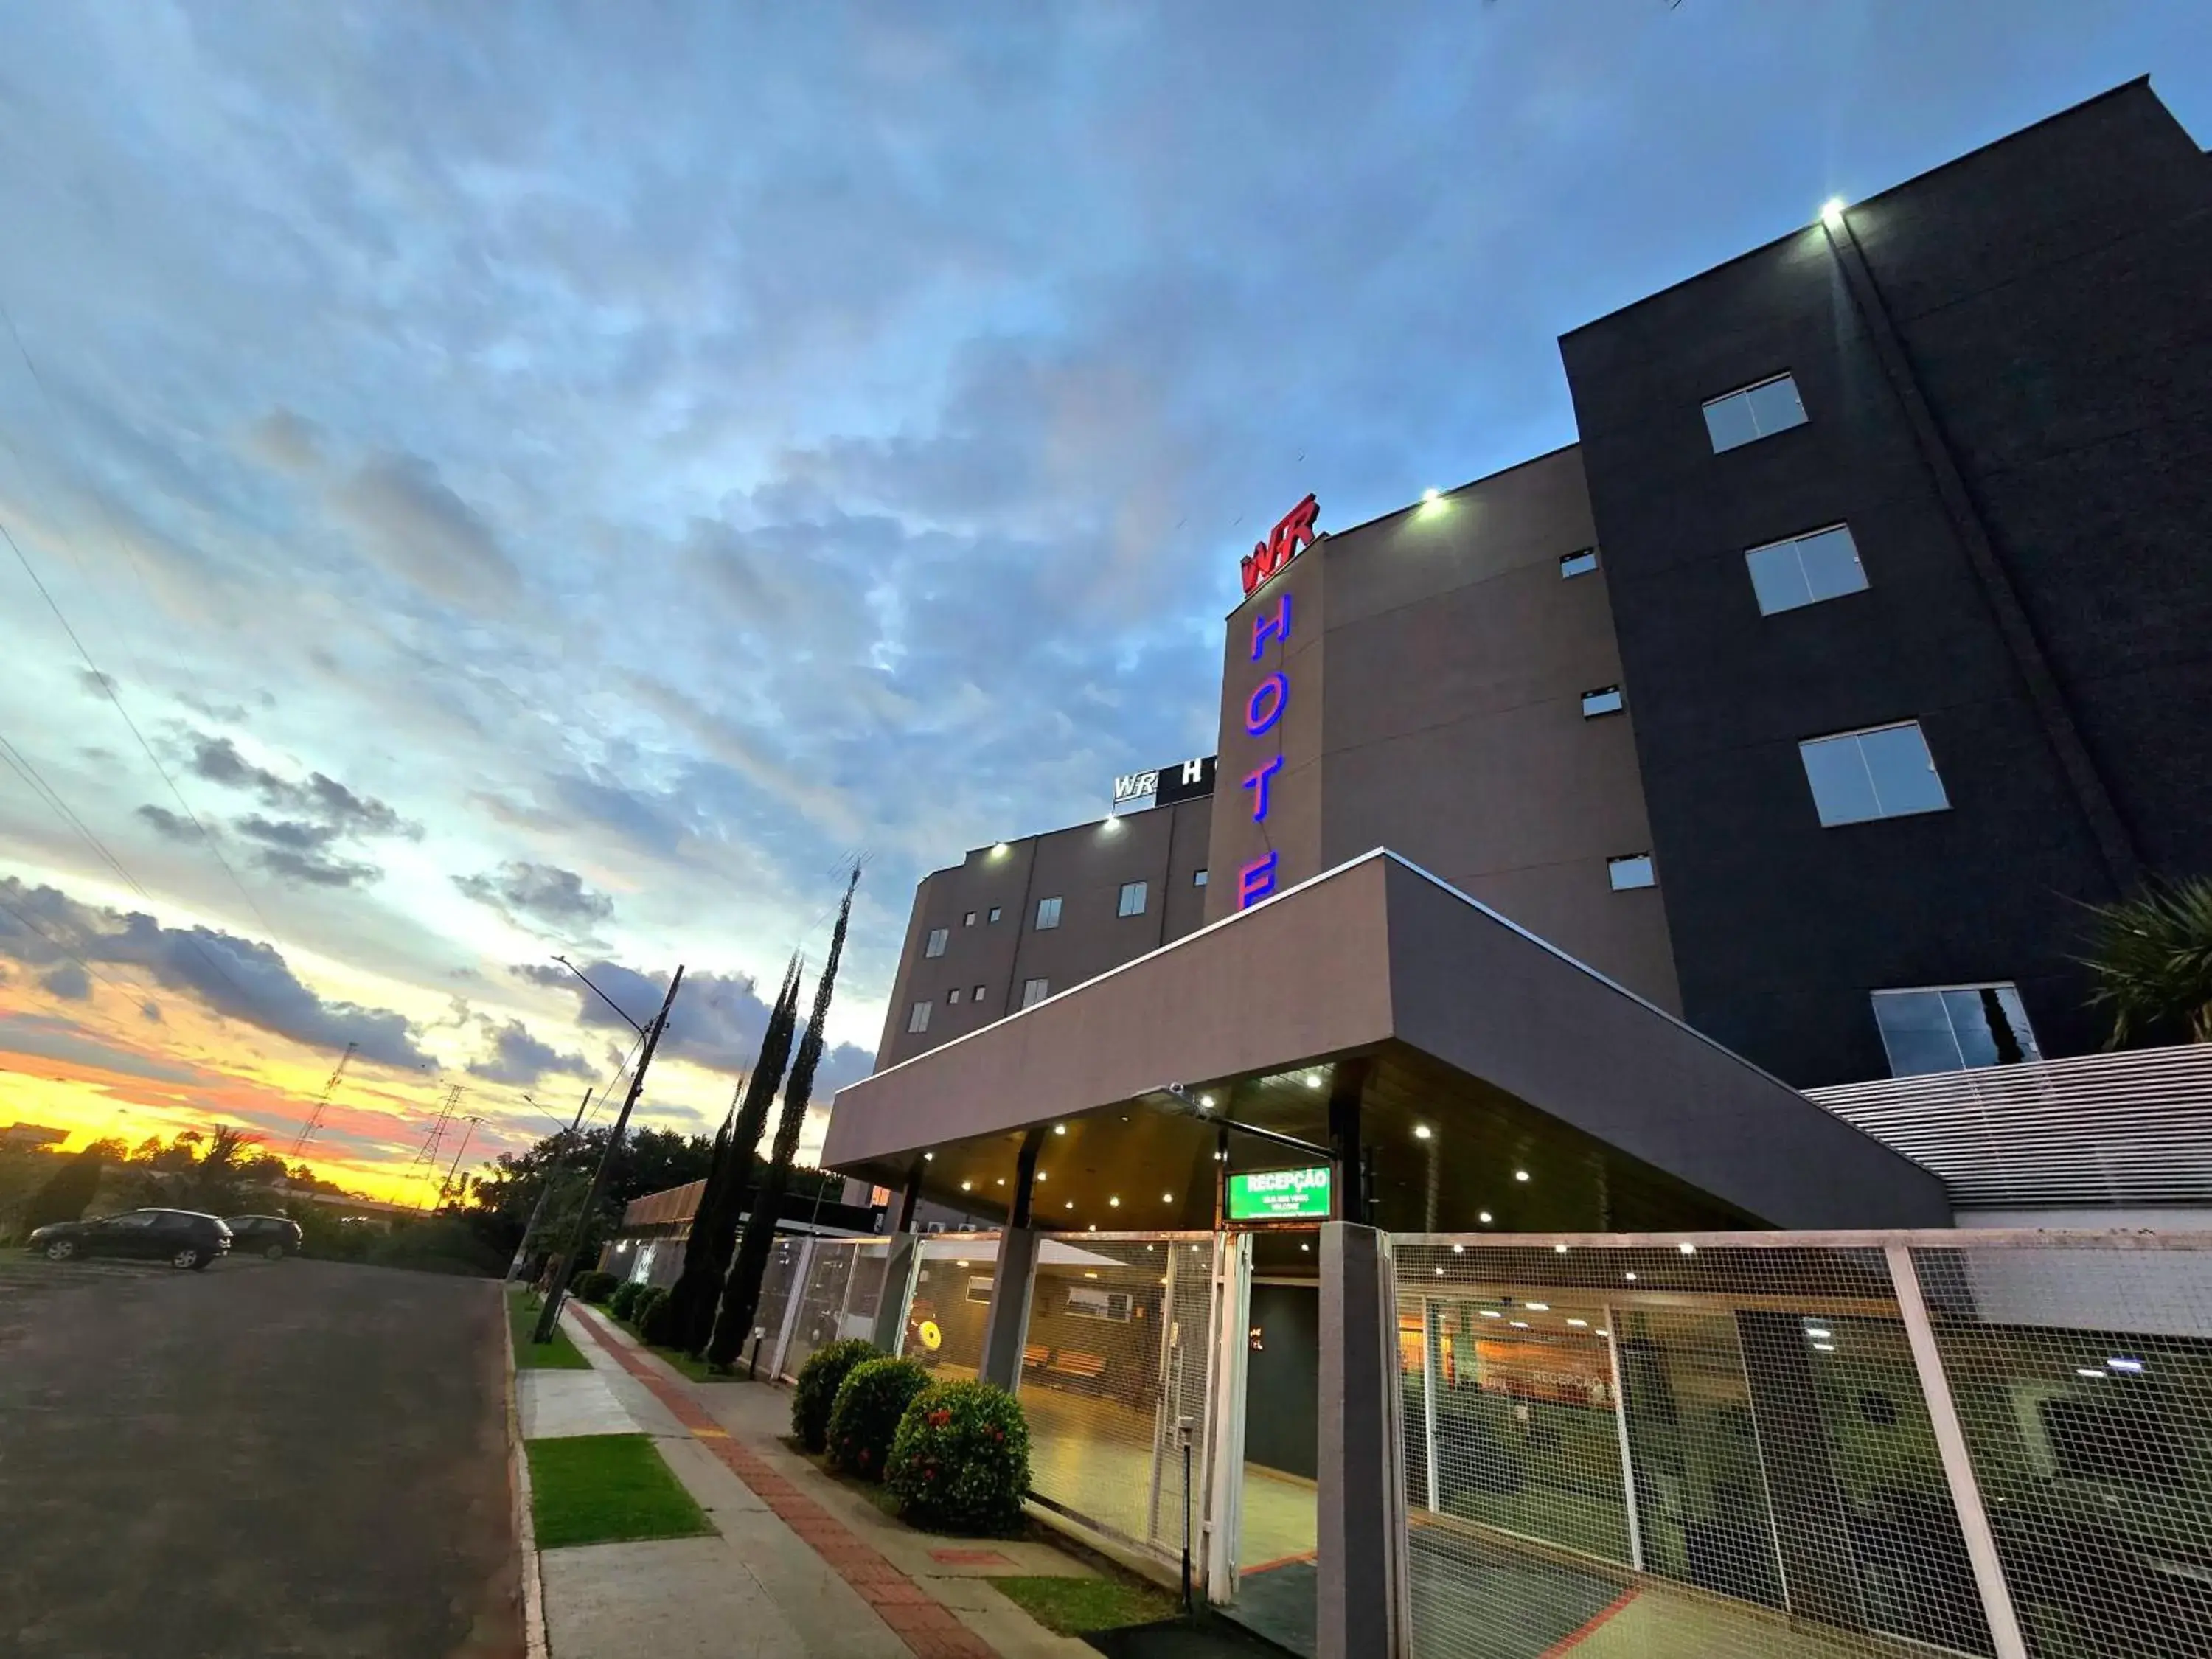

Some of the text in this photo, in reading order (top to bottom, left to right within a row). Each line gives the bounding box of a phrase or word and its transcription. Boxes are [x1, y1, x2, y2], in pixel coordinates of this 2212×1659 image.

[1240, 493, 1321, 595] WR
[1114, 758, 1217, 799] WR H
[1248, 1169, 1327, 1192] RECEPÇÃO
